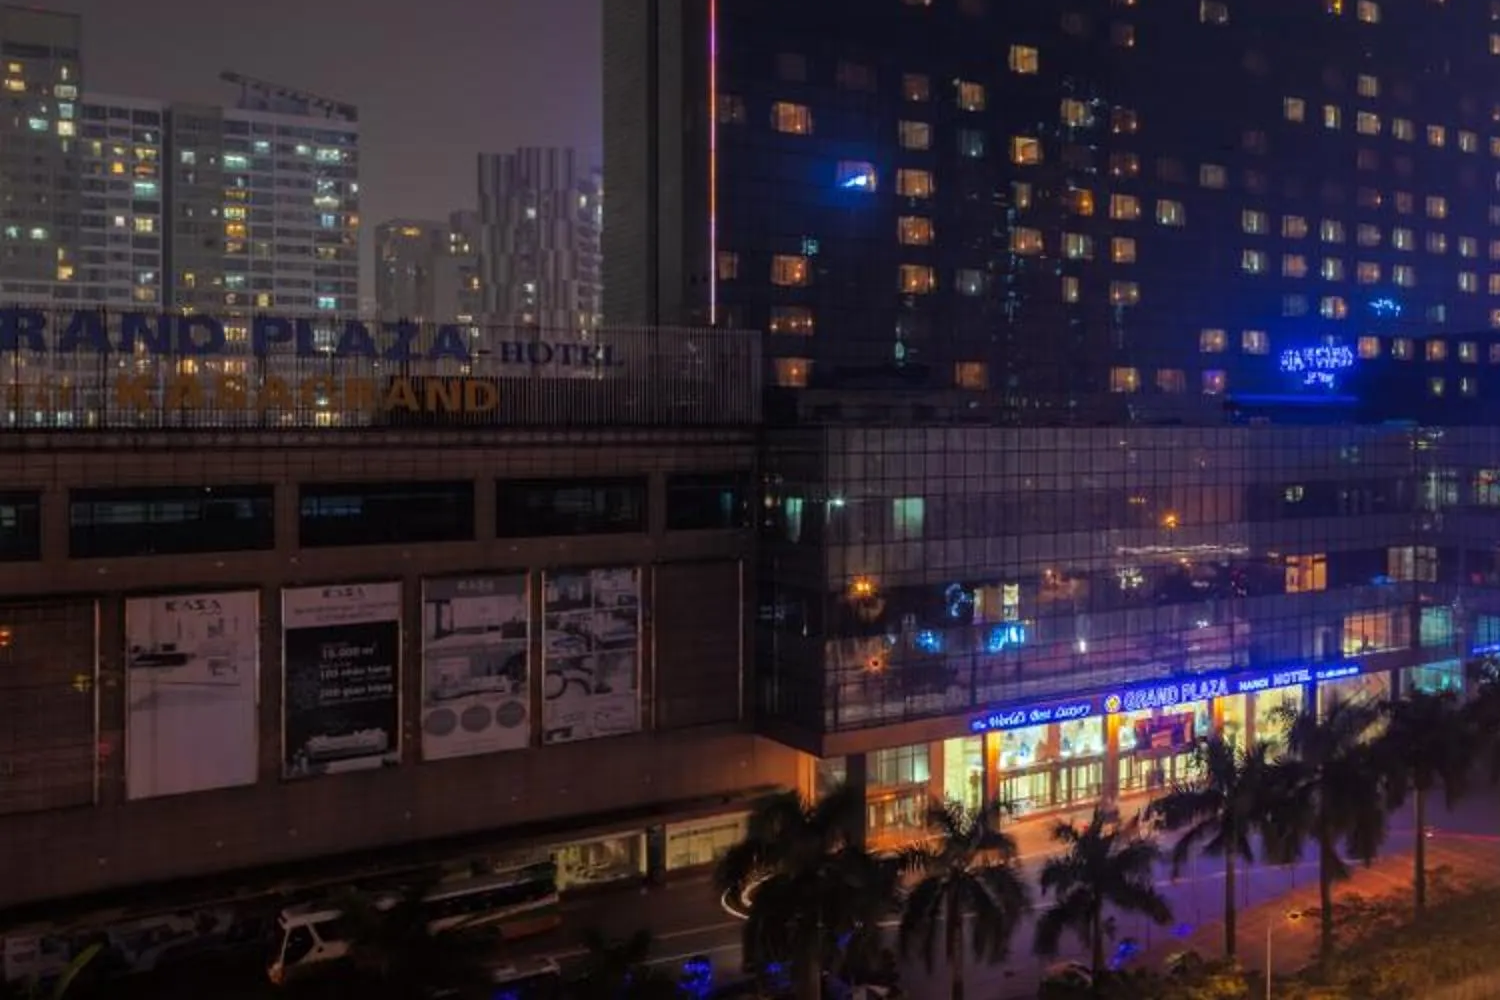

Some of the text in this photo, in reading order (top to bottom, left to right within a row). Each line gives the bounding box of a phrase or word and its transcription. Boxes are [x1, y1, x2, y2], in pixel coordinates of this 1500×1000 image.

[252, 314, 474, 360] PLAZA
[499, 341, 626, 366] HOTEL
[1123, 685, 1179, 711] GRAND
[1181, 676, 1229, 702] PLAZA
[1273, 668, 1313, 687] HOTEL
